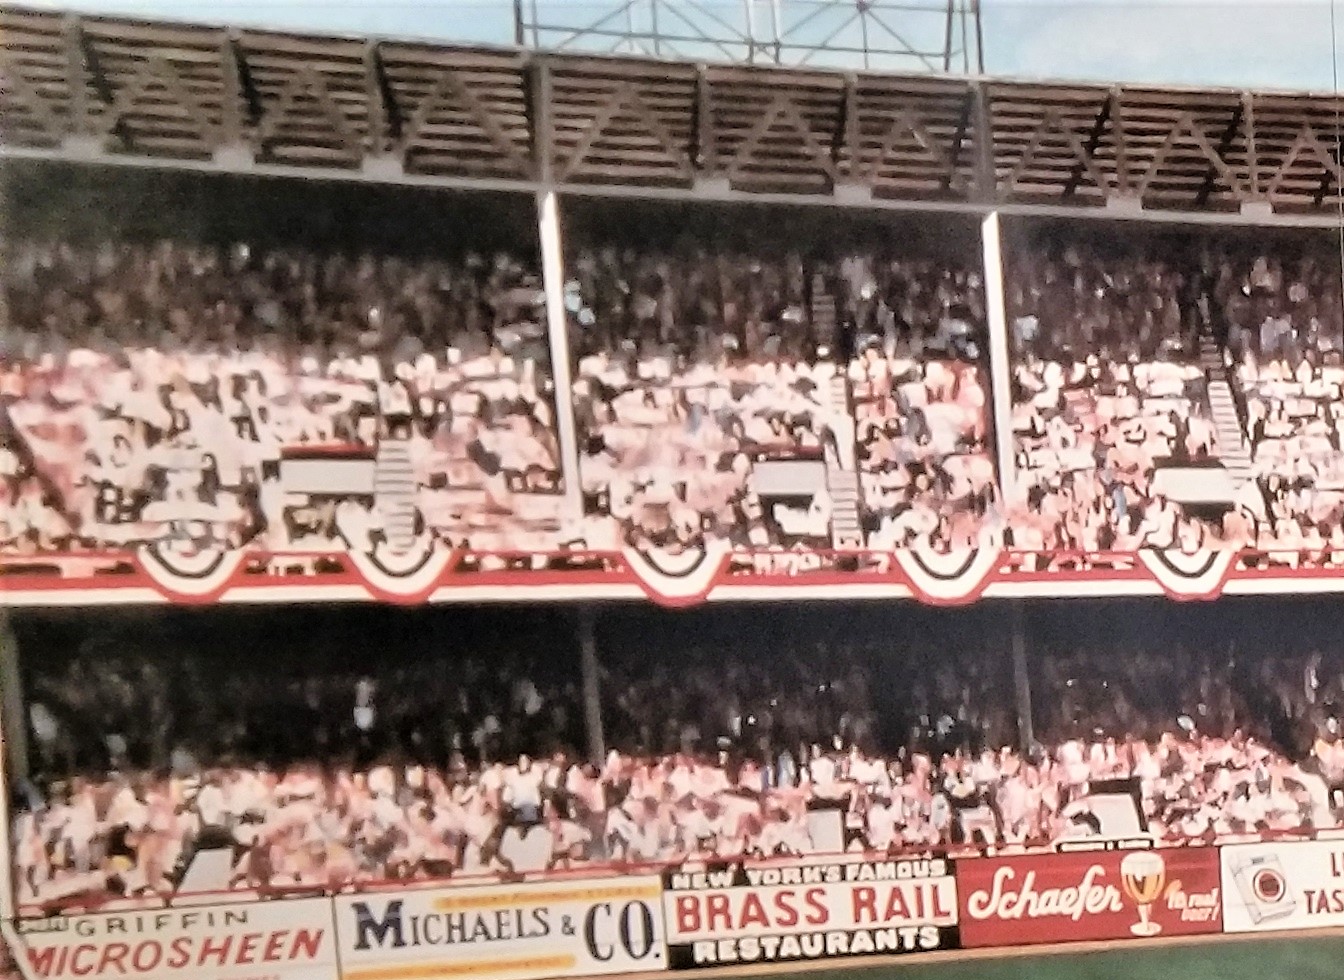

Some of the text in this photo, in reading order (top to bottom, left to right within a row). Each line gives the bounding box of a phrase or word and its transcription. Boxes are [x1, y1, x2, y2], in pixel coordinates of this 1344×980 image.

[672, 859, 947, 889] NEW YORK'S FAMOUS
[968, 865, 1123, 920] Schaefer
[75, 909, 249, 937] GRIFFIN
[352, 899, 661, 961] MICHAELS & CO.
[676, 887, 829, 933] BRASS
[851, 884, 950, 923] RAIL
[27, 928, 325, 976] MICROSHEEN
[693, 926, 941, 963] RESTAURANTS
